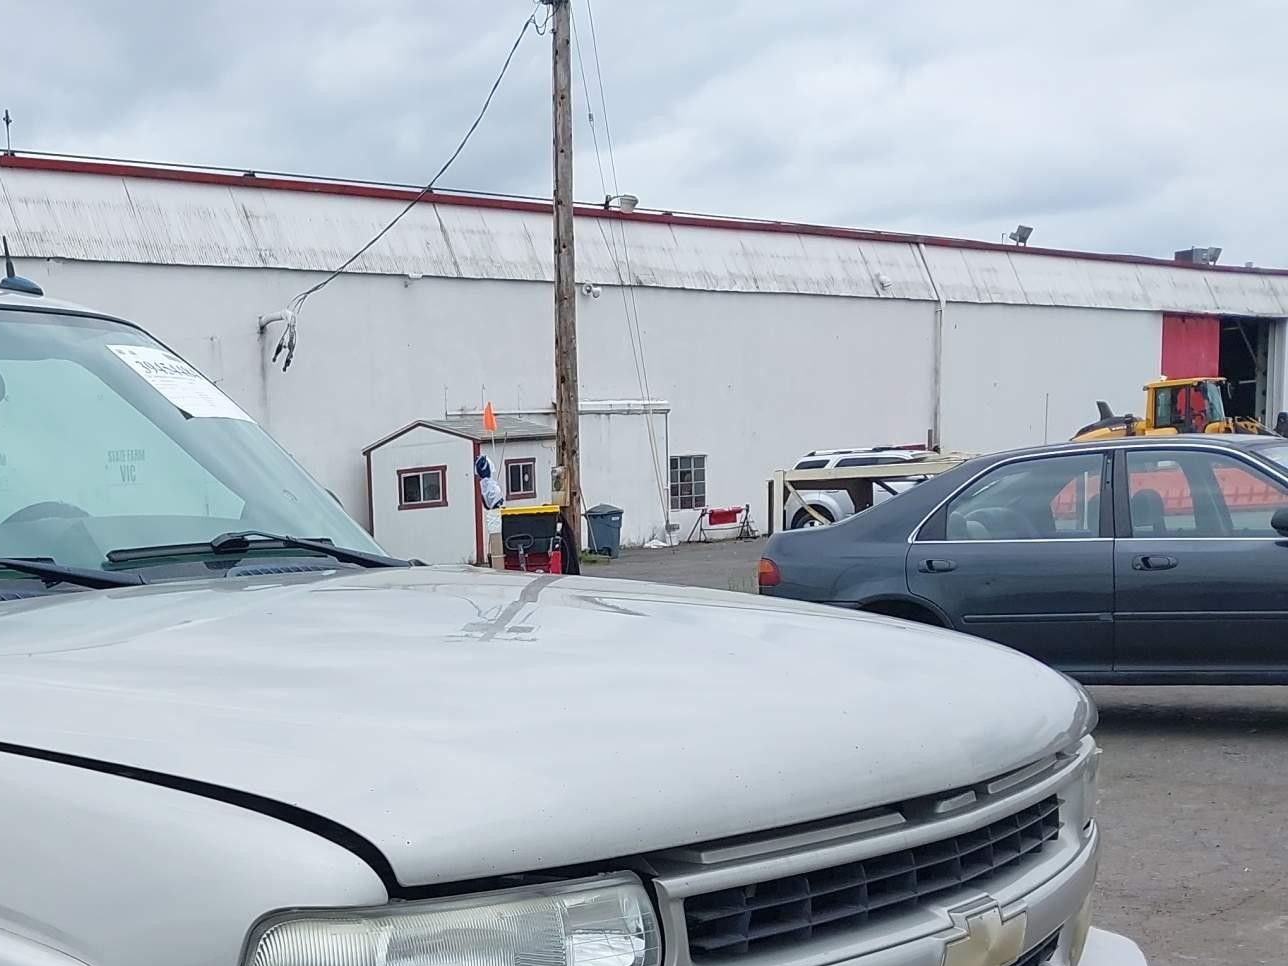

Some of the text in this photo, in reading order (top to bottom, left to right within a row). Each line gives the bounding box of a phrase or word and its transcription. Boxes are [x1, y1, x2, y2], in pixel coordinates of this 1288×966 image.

[107, 449, 145, 463] STATE FARM
[119, 464, 136, 482] VIC
